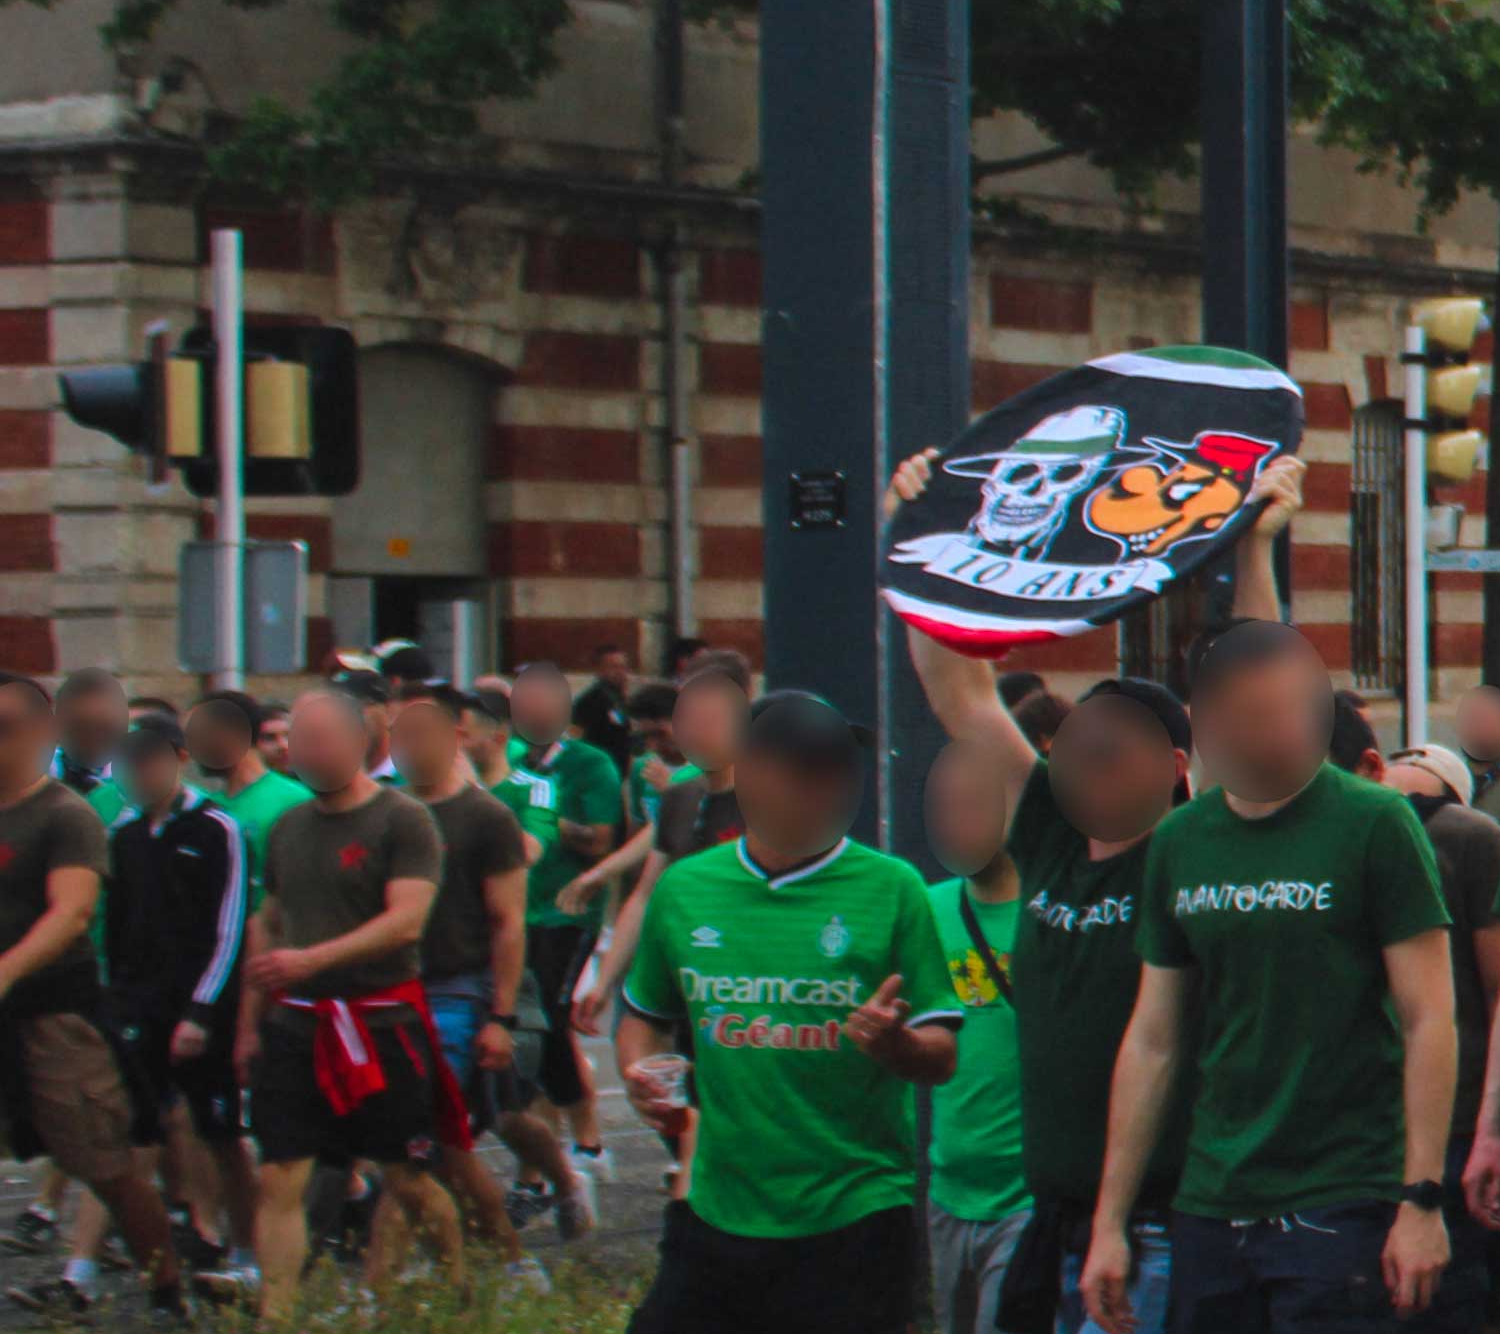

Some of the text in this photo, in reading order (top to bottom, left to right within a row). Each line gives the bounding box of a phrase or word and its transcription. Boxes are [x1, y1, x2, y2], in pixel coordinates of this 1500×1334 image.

[949, 554, 1125, 597] 10 ANS
[679, 967, 863, 1007] Dreamcast
[713, 1013, 843, 1051] Géant
